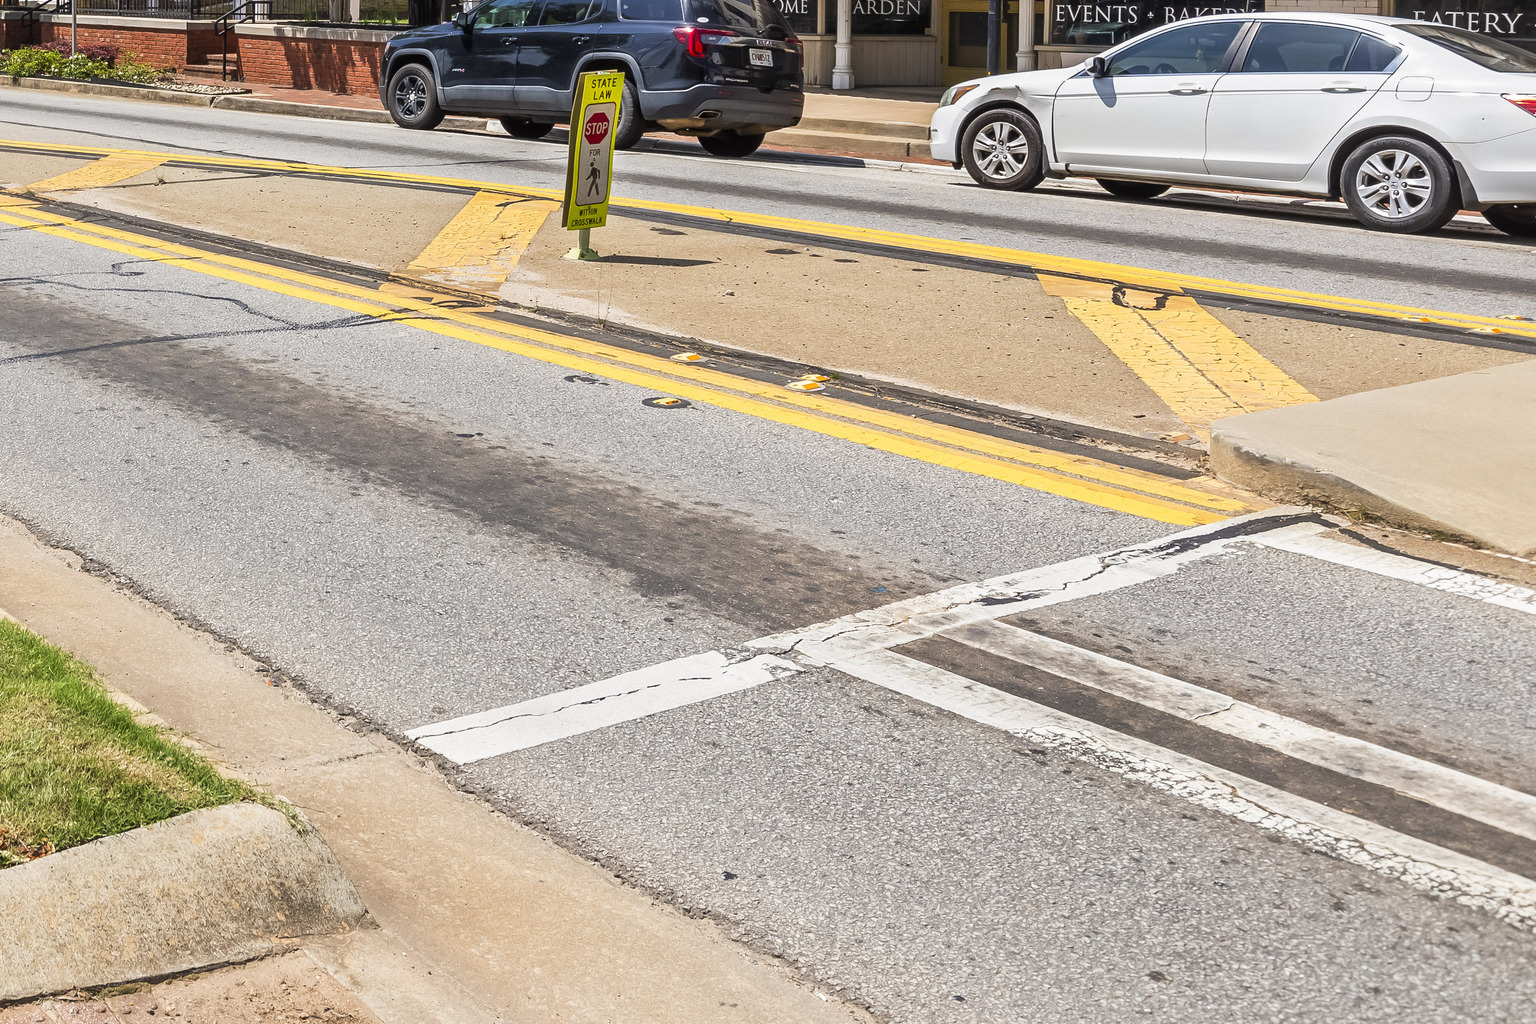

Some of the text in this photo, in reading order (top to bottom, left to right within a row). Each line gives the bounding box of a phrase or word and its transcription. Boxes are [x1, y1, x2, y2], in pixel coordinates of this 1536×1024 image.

[852, 0, 921, 15] ARDEN
[1055, 5, 1138, 24] EVENTS
[591, 77, 617, 89] STATE
[593, 89, 613, 101] LAW
[585, 121, 609, 136] STOP
[589, 148, 601, 157] FOR
[579, 208, 598, 217] WITHIN
[571, 216, 603, 227] CROSSWALK
